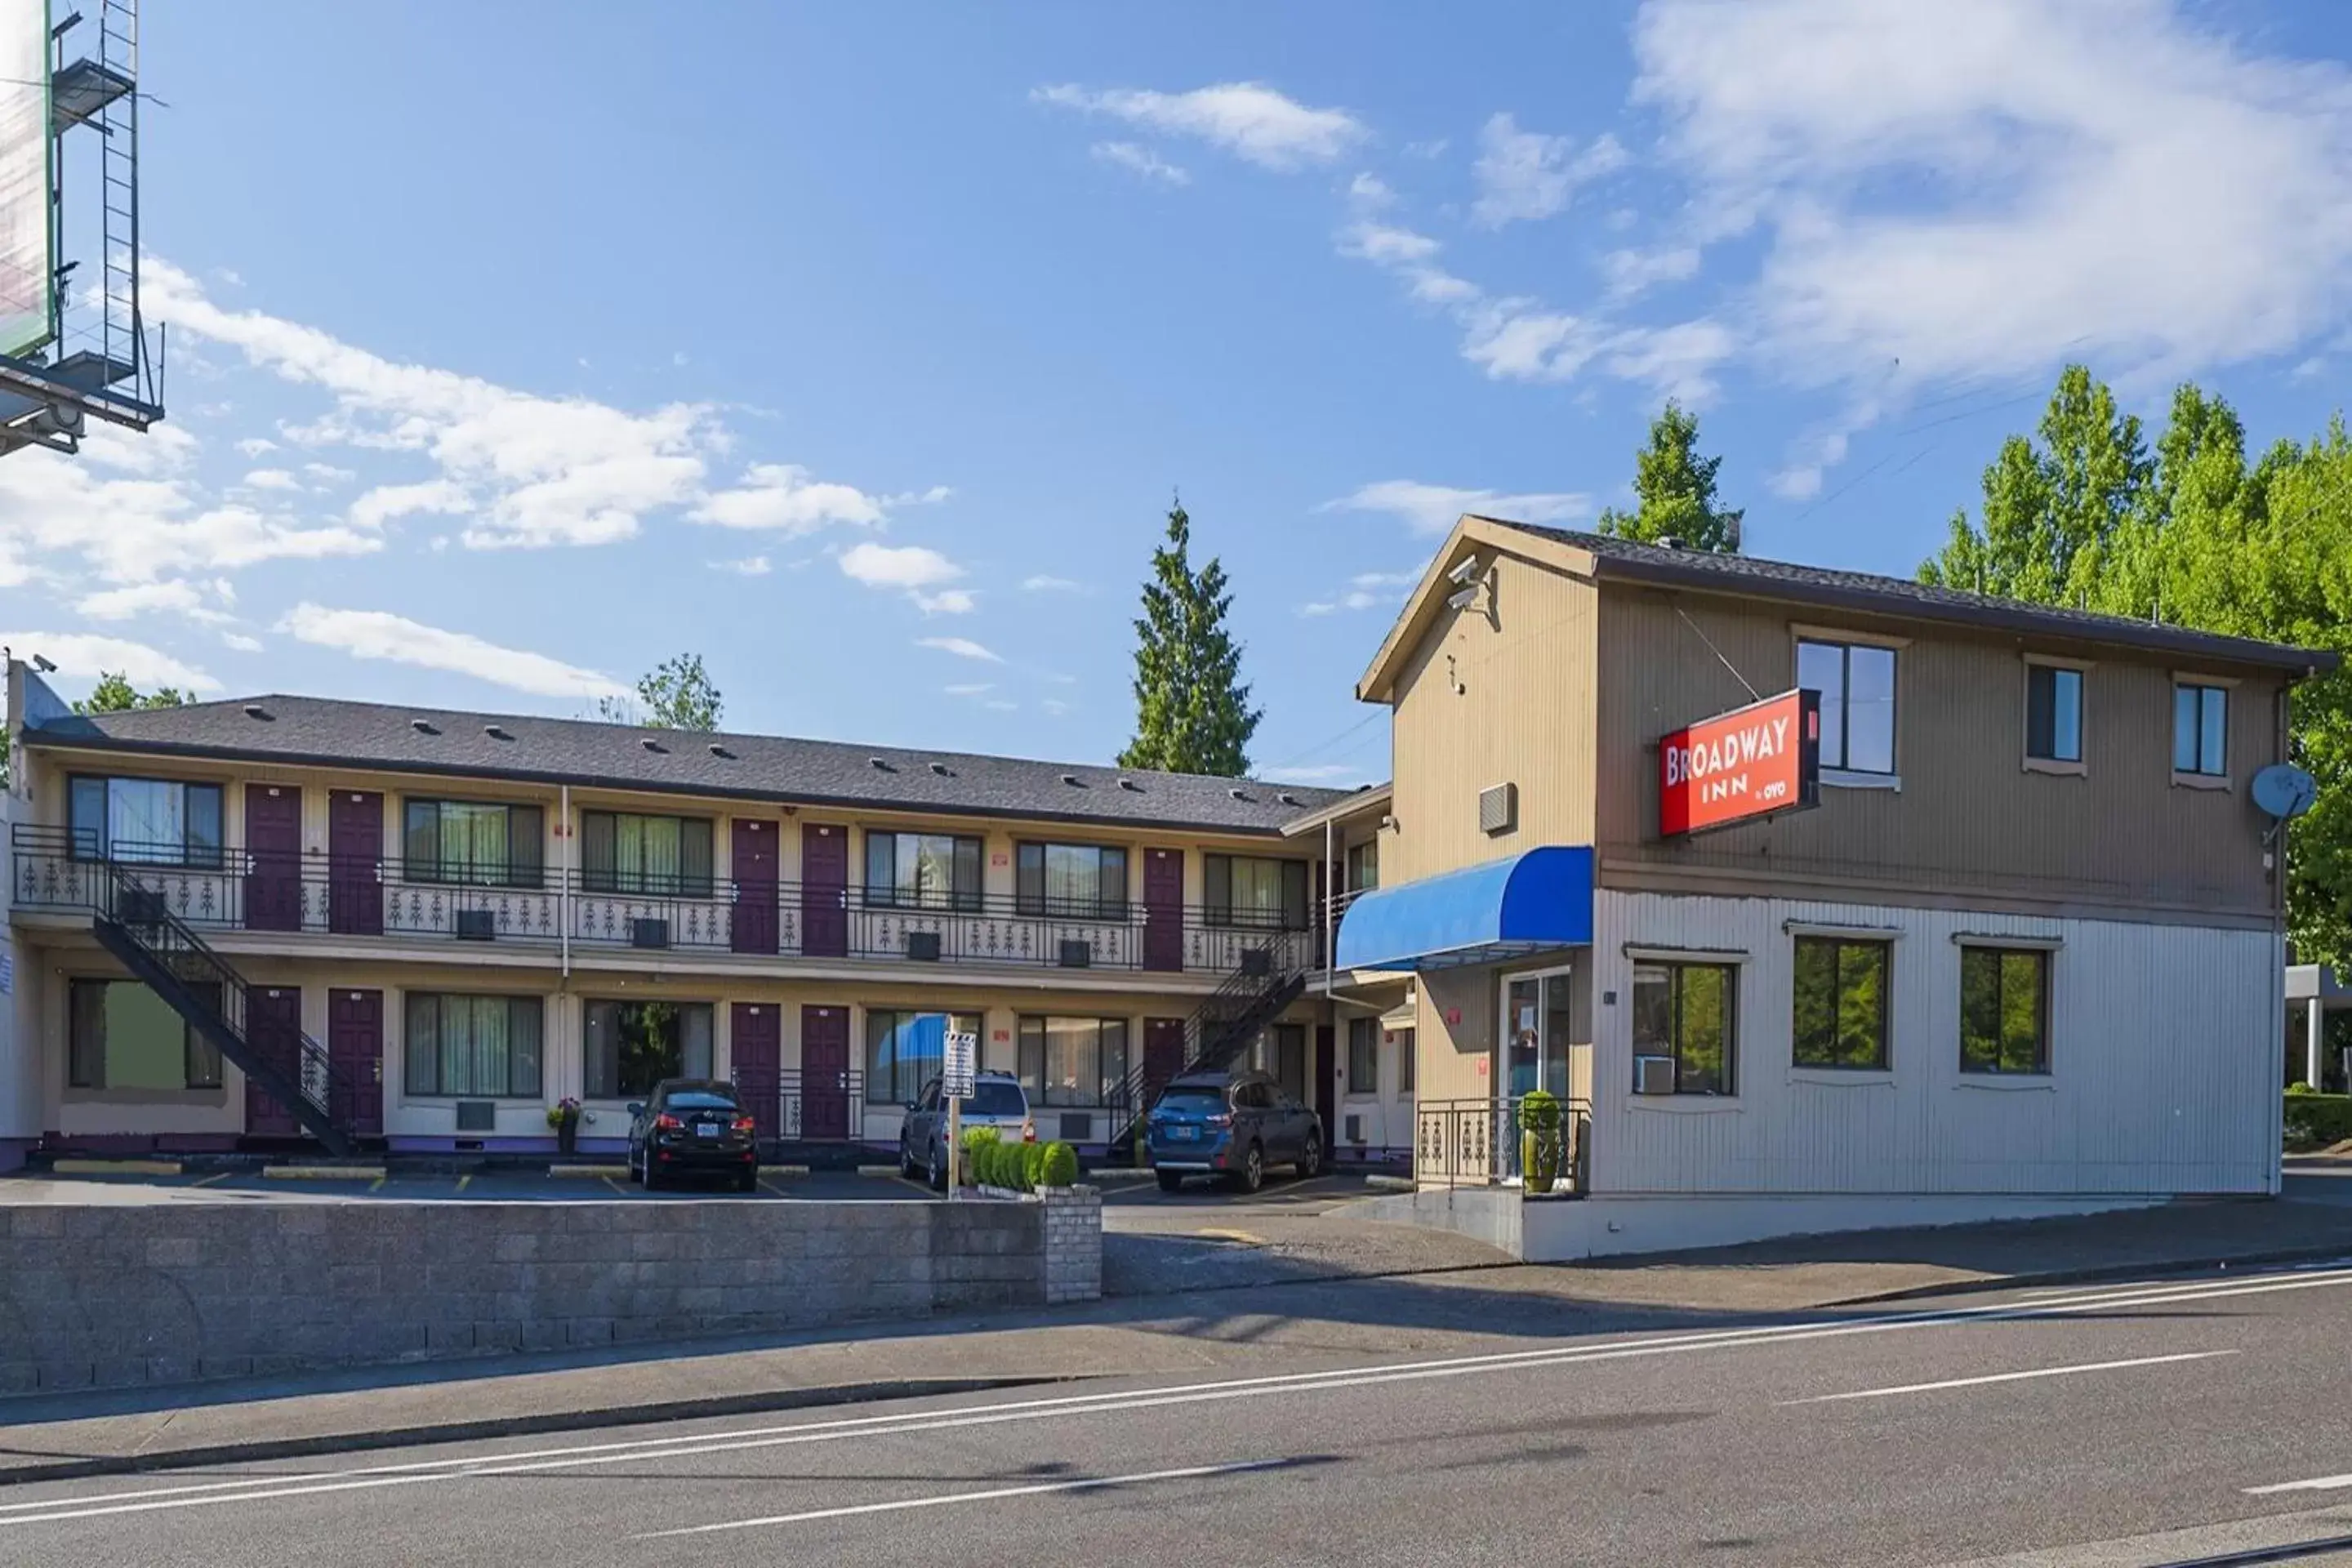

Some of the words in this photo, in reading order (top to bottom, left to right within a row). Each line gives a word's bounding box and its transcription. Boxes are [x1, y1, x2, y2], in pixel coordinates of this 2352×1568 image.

[1666, 715, 1789, 787] BROADWAY
[1701, 773, 1748, 804] INN
[1764, 780, 1786, 800] OYO
